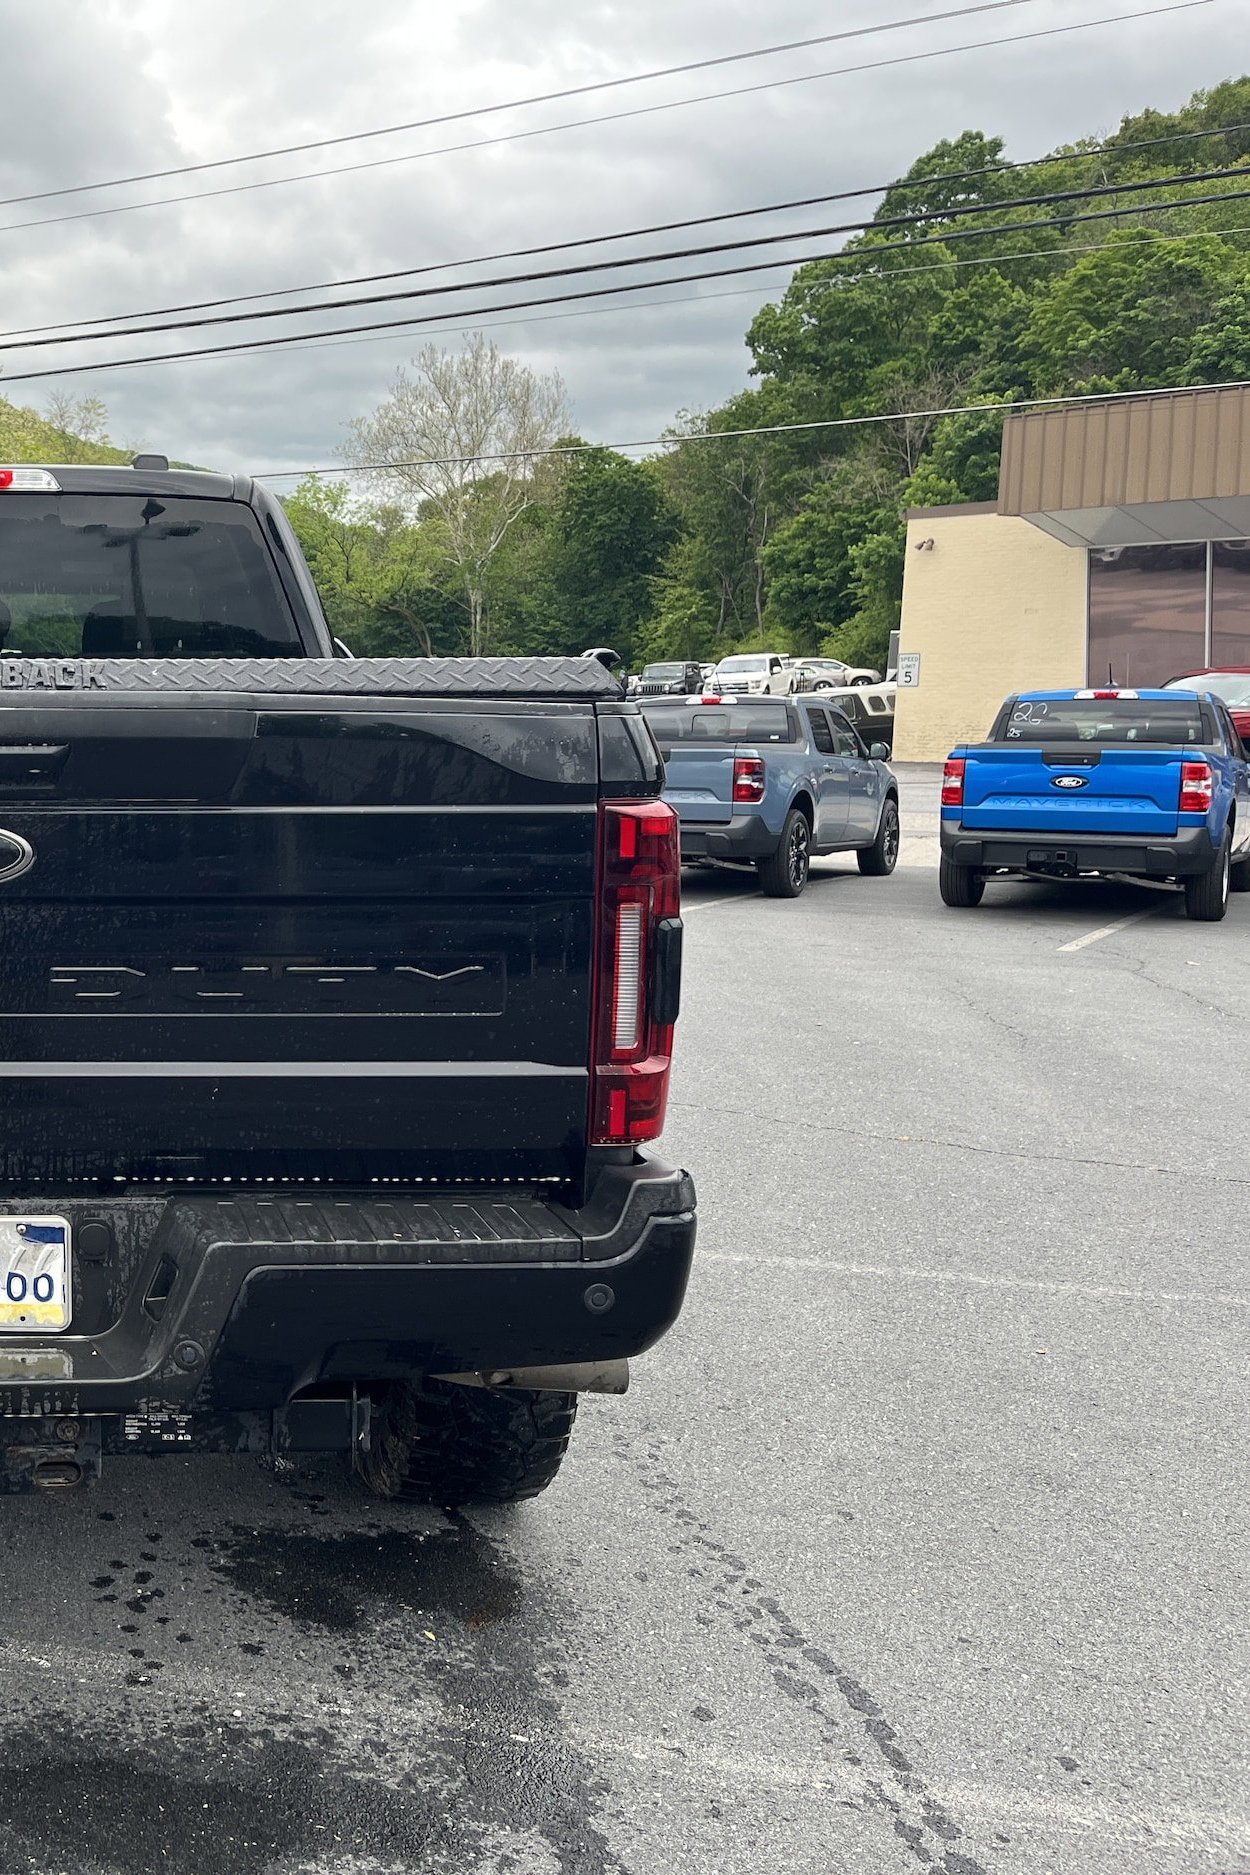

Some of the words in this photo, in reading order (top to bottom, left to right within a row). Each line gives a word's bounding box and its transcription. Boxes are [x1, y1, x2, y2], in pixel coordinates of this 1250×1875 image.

[903, 671, 912, 684] 5
[992, 797, 1147, 809] MAVERICK
[50, 966, 485, 1002] DUTY
